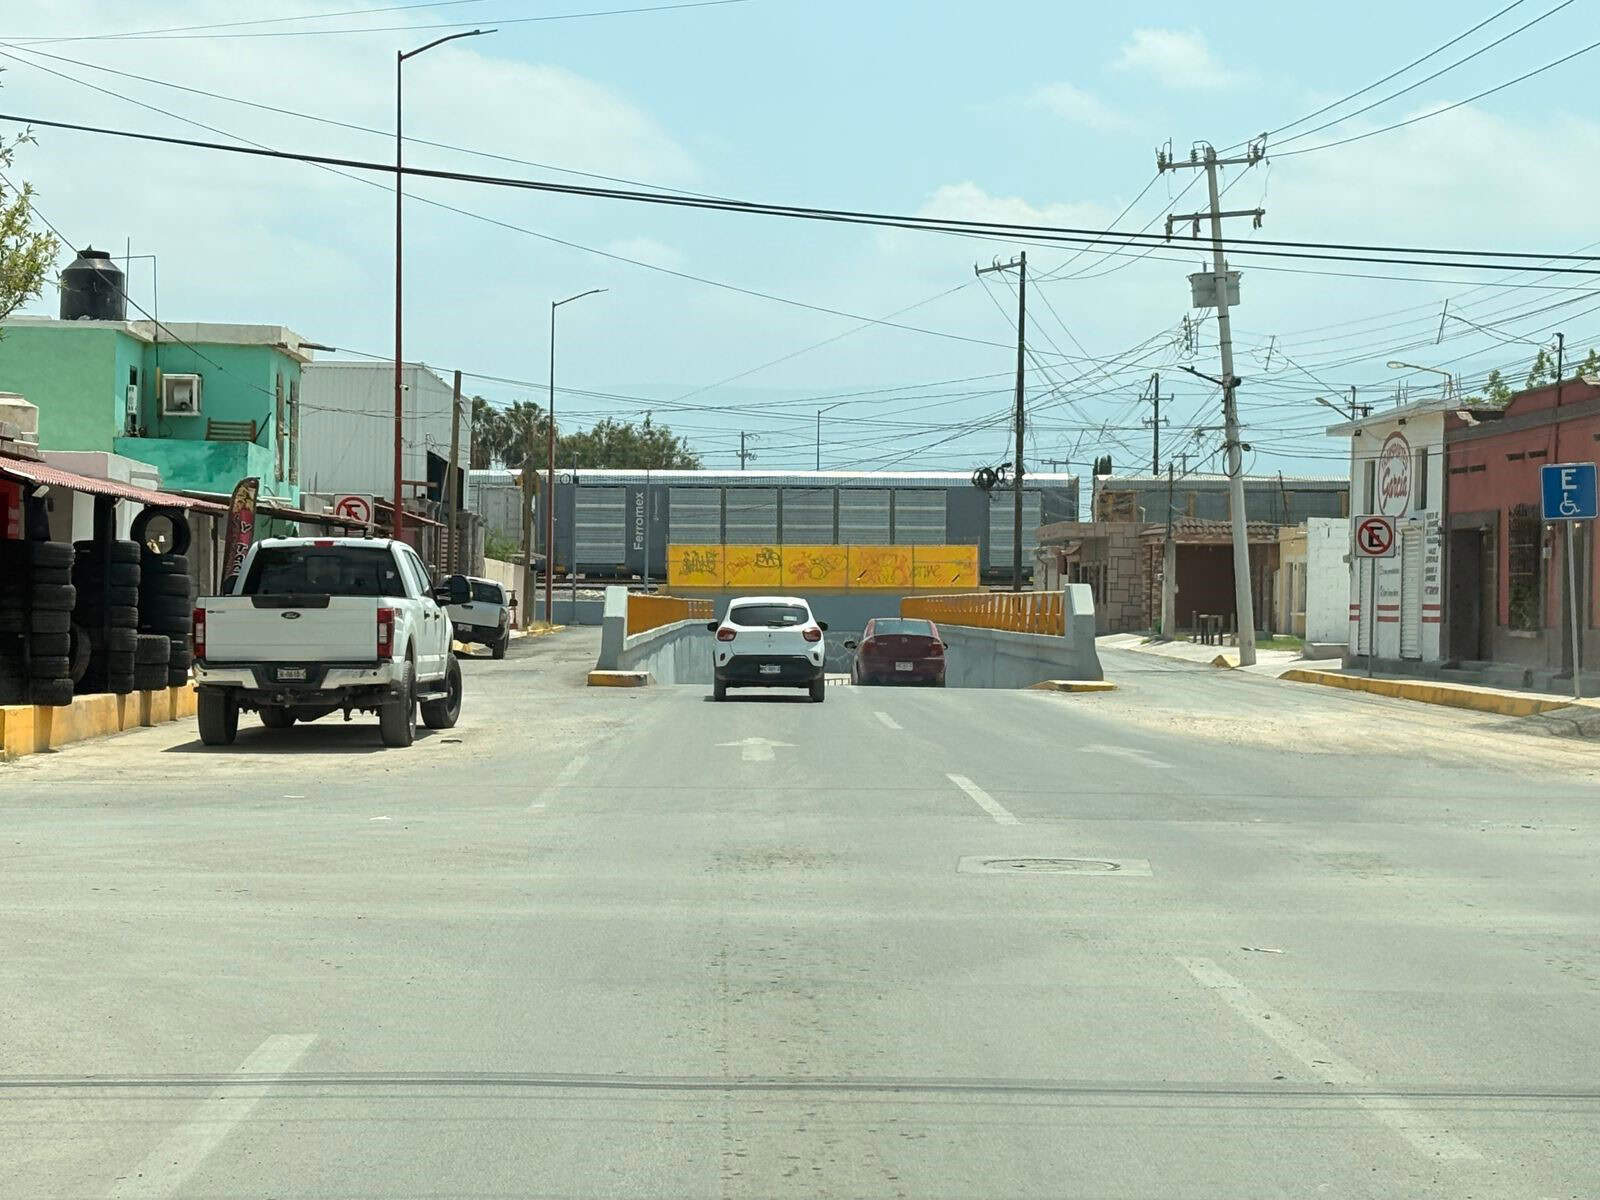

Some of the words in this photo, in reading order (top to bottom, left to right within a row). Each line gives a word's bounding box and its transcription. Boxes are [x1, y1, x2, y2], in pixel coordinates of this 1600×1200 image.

[1561, 469, 1577, 490] E
[633, 492, 644, 550] Ferromex
[1368, 526, 1384, 548] E
